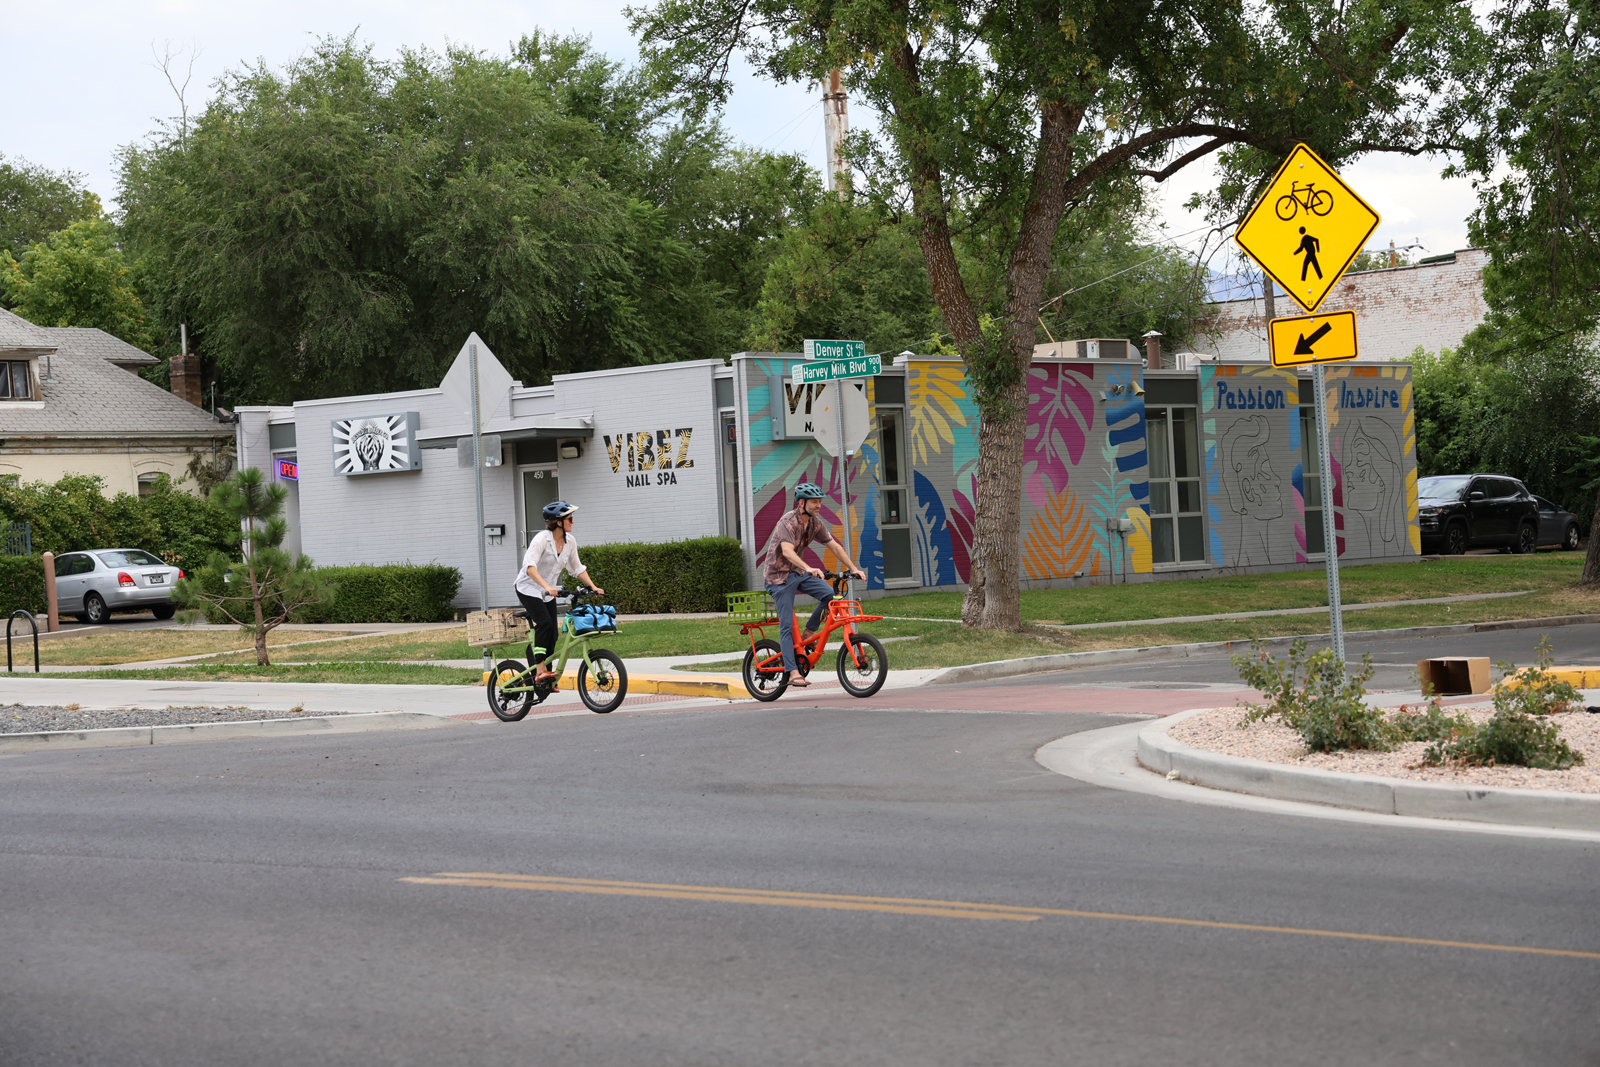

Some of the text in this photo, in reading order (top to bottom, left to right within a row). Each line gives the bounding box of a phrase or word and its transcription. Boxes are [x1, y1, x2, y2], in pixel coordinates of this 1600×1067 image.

[816, 343, 844, 357] Denver
[846, 344, 854, 357] St
[868, 357, 880, 365] 900
[803, 366, 828, 380] Harvey
[831, 363, 846, 375] Milk
[850, 360, 866, 373] Blvd
[1216, 381, 1285, 409] Passion
[1341, 380, 1399, 408] Inspire
[603, 428, 694, 473] VIBEZ
[281, 463, 297, 477] OPEN
[534, 471, 544, 479] 450
[626, 472, 677, 488] NAIL SPA
